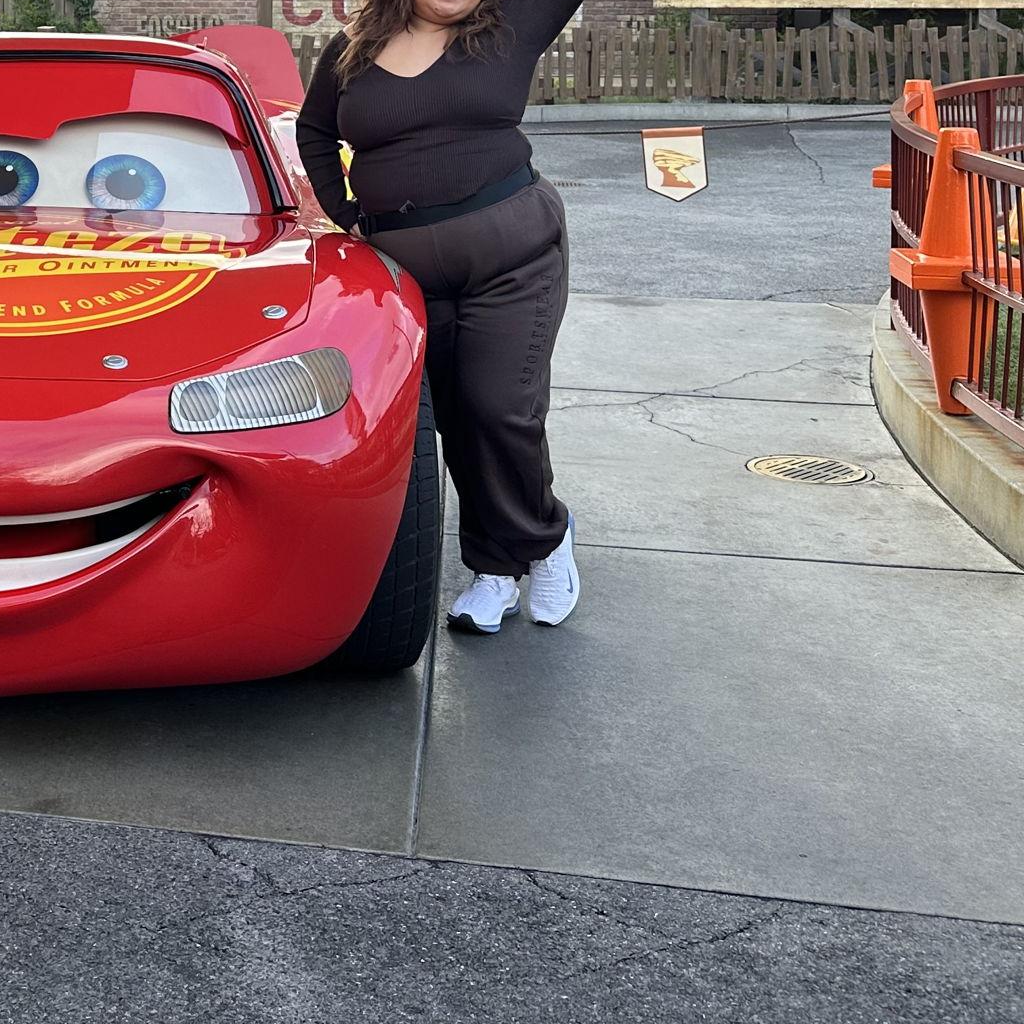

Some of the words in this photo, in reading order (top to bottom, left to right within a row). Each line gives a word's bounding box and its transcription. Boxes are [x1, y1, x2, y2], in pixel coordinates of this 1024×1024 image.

[38, 259, 193, 272] OINTMEN
[59, 276, 166, 313] FORMULA
[519, 274, 554, 385] SPORTSWEAR
